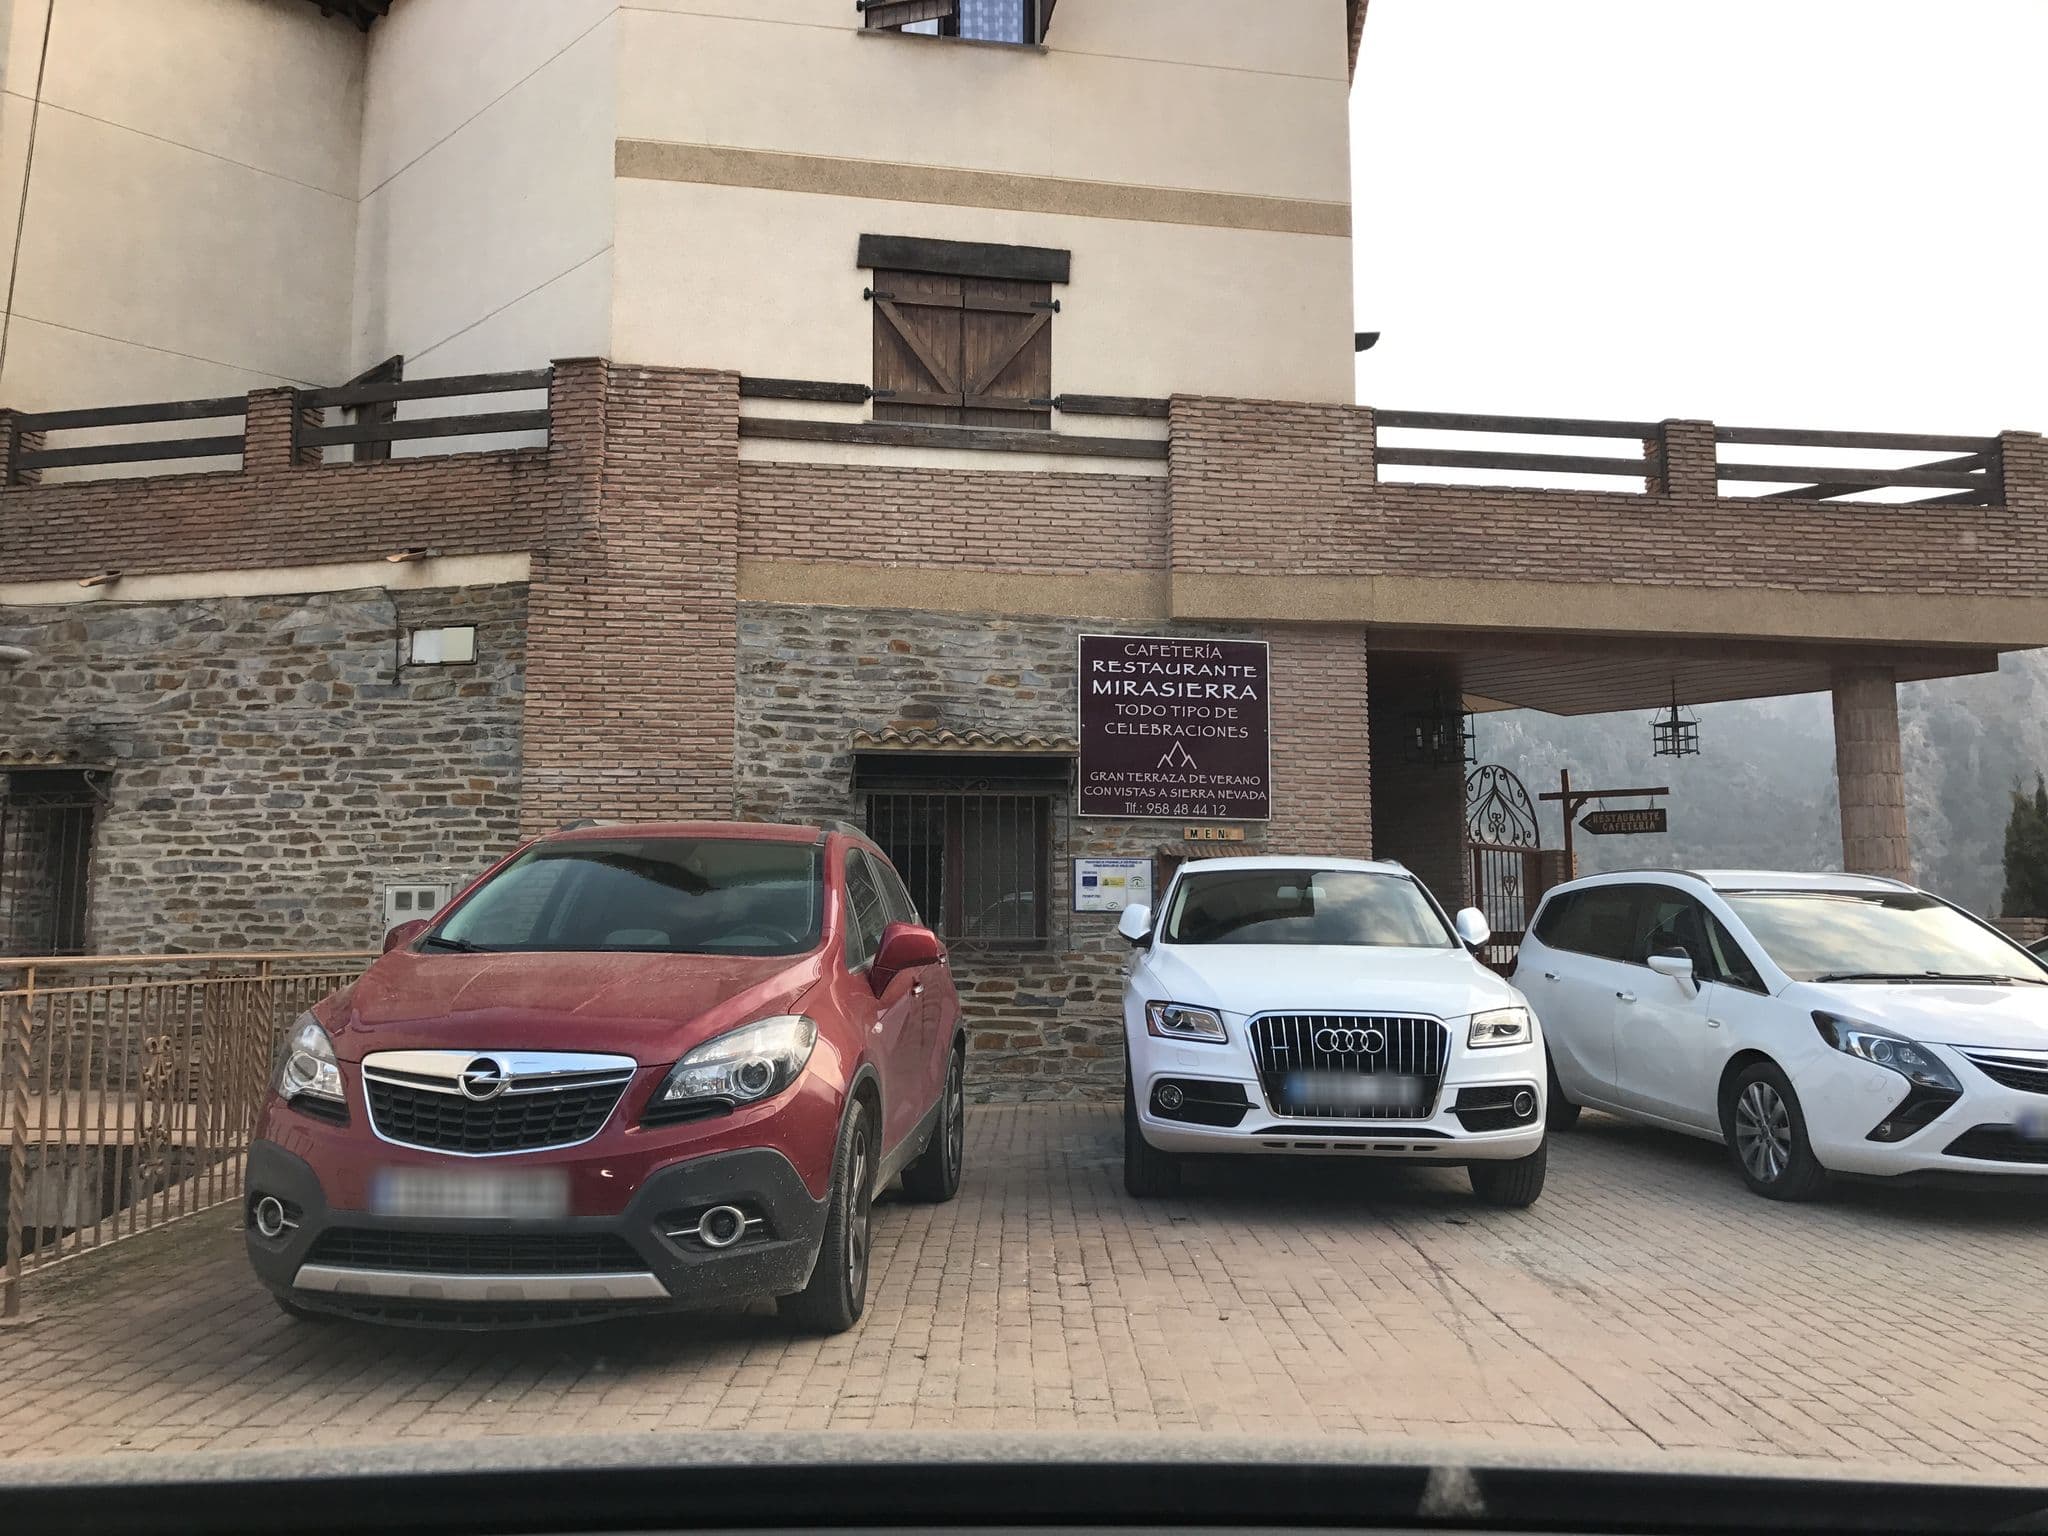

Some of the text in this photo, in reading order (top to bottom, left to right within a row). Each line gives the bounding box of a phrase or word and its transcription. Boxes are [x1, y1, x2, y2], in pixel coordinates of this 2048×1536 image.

[1124, 643, 1223, 660] CAFETERÍA
[1092, 660, 1258, 678] RESTAURANTE
[1092, 679, 1258, 701] MIRASIERRA
[1115, 703, 1239, 719] TODO TIPO DE
[1104, 722, 1249, 739] CELEBRACIONES
[1090, 771, 1261, 785] GRAN TERRAZA DE VERANO
[1084, 785, 1267, 800] CON VISTAS A SIERRA NEVADA
[1146, 802, 1170, 814] 958
[1173, 803, 1189, 815] 48
[1192, 804, 1208, 815] 44
[1212, 804, 1227, 816] 12
